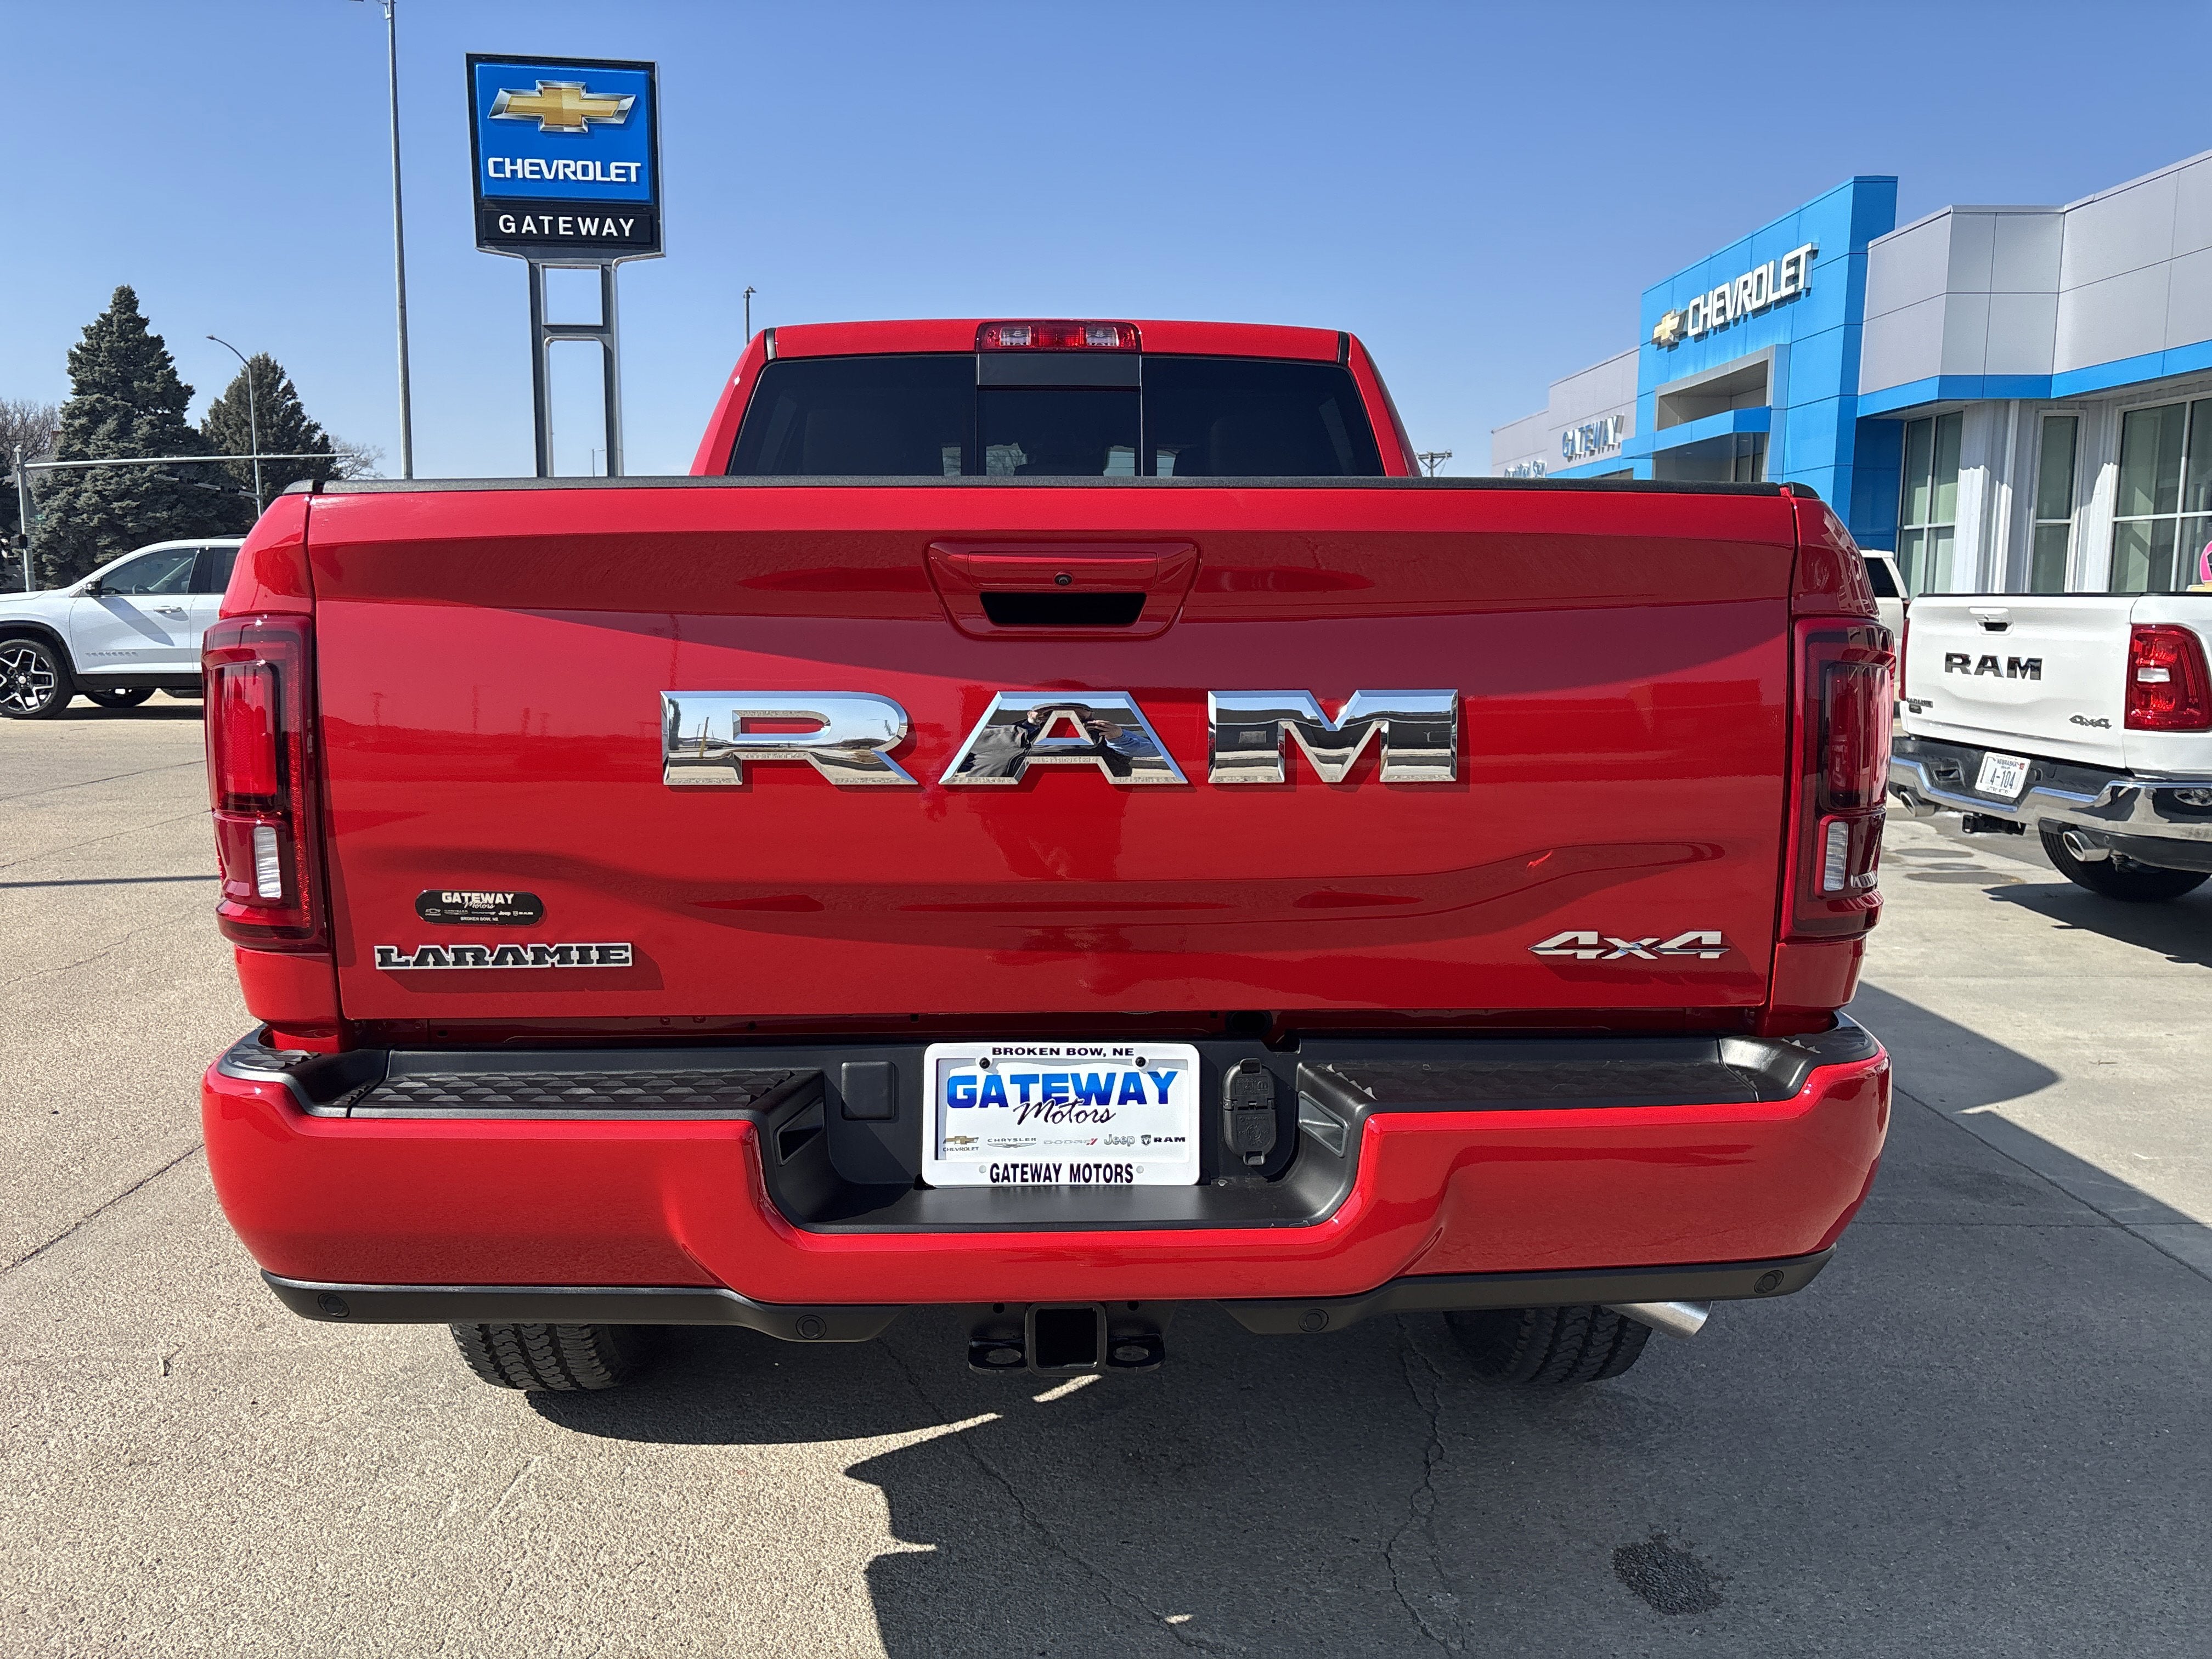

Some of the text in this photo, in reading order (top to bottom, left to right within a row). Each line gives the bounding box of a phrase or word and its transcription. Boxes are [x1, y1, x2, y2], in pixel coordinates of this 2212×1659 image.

[488, 157, 641, 182] CHEVROLET
[498, 214, 635, 237] GATEWAY
[1687, 242, 1817, 337] CHEVROLET
[1562, 415, 1623, 458] GATEWAY
[1944, 652, 2043, 681] RAM
[659, 689, 1459, 786] RAM
[1990, 768, 2016, 789] 4-104
[442, 892, 515, 904] GATEWAY
[463, 900, 496, 909] Motors
[374, 943, 633, 970] LARAMIE
[992, 1047, 1134, 1058] BROKEN BOW, NE
[947, 1071, 1178, 1109] GATEWAY
[1013, 1098, 1116, 1125] Motors
[1103, 1133, 1136, 1147] Jeep
[990, 1163, 1134, 1183] GATEWAY MOTORS
